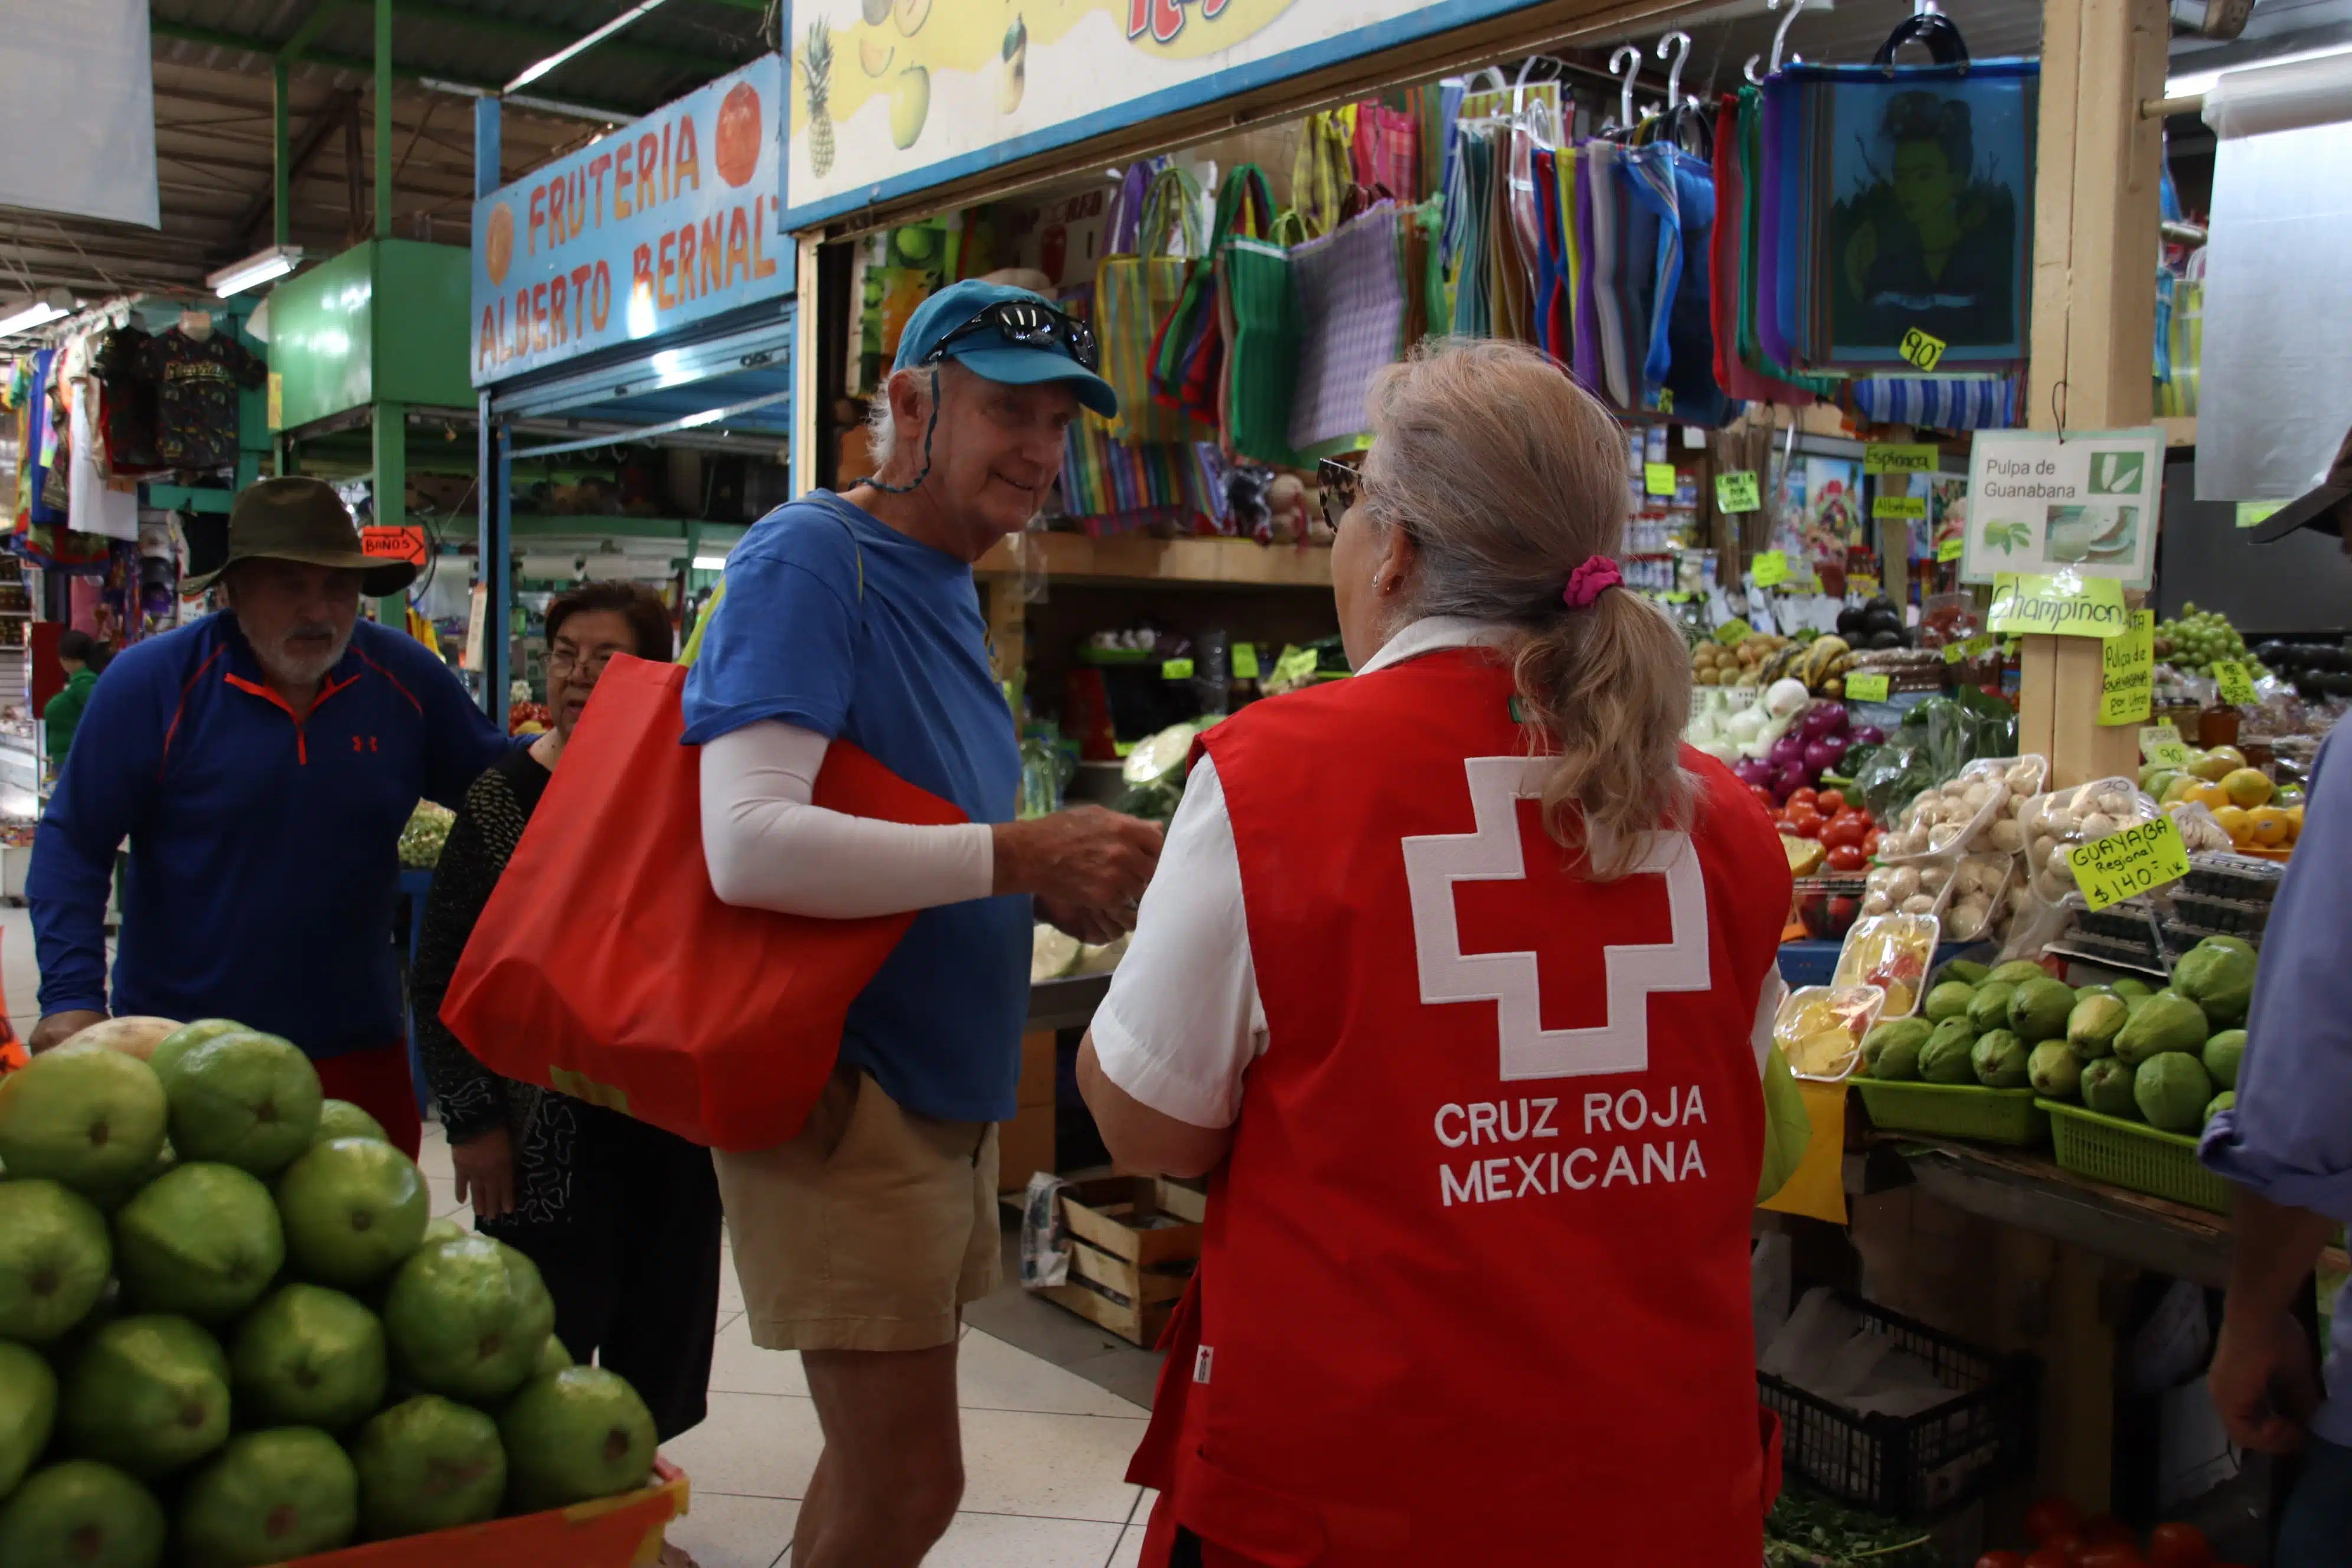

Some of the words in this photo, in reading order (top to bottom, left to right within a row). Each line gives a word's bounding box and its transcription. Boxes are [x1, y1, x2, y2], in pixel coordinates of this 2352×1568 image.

[528, 113, 700, 255] FRUTERIA
[478, 260, 612, 371] ALBERTO
[1986, 459, 2030, 479] Pulpa
[2036, 459, 2056, 475] de
[1984, 481, 2076, 498] Guanabana
[2106, 643, 2131, 673] Pulpa
[2133, 642, 2146, 662] de
[2111, 698, 2125, 713] por
[2073, 819, 2167, 866] GUAYABA
[2096, 841, 2154, 874] Regional
[1434, 1097, 1559, 1148] CRUZ
[1584, 1085, 1707, 1134] ROJA
[1439, 1139, 1707, 1207] MEXICANA
